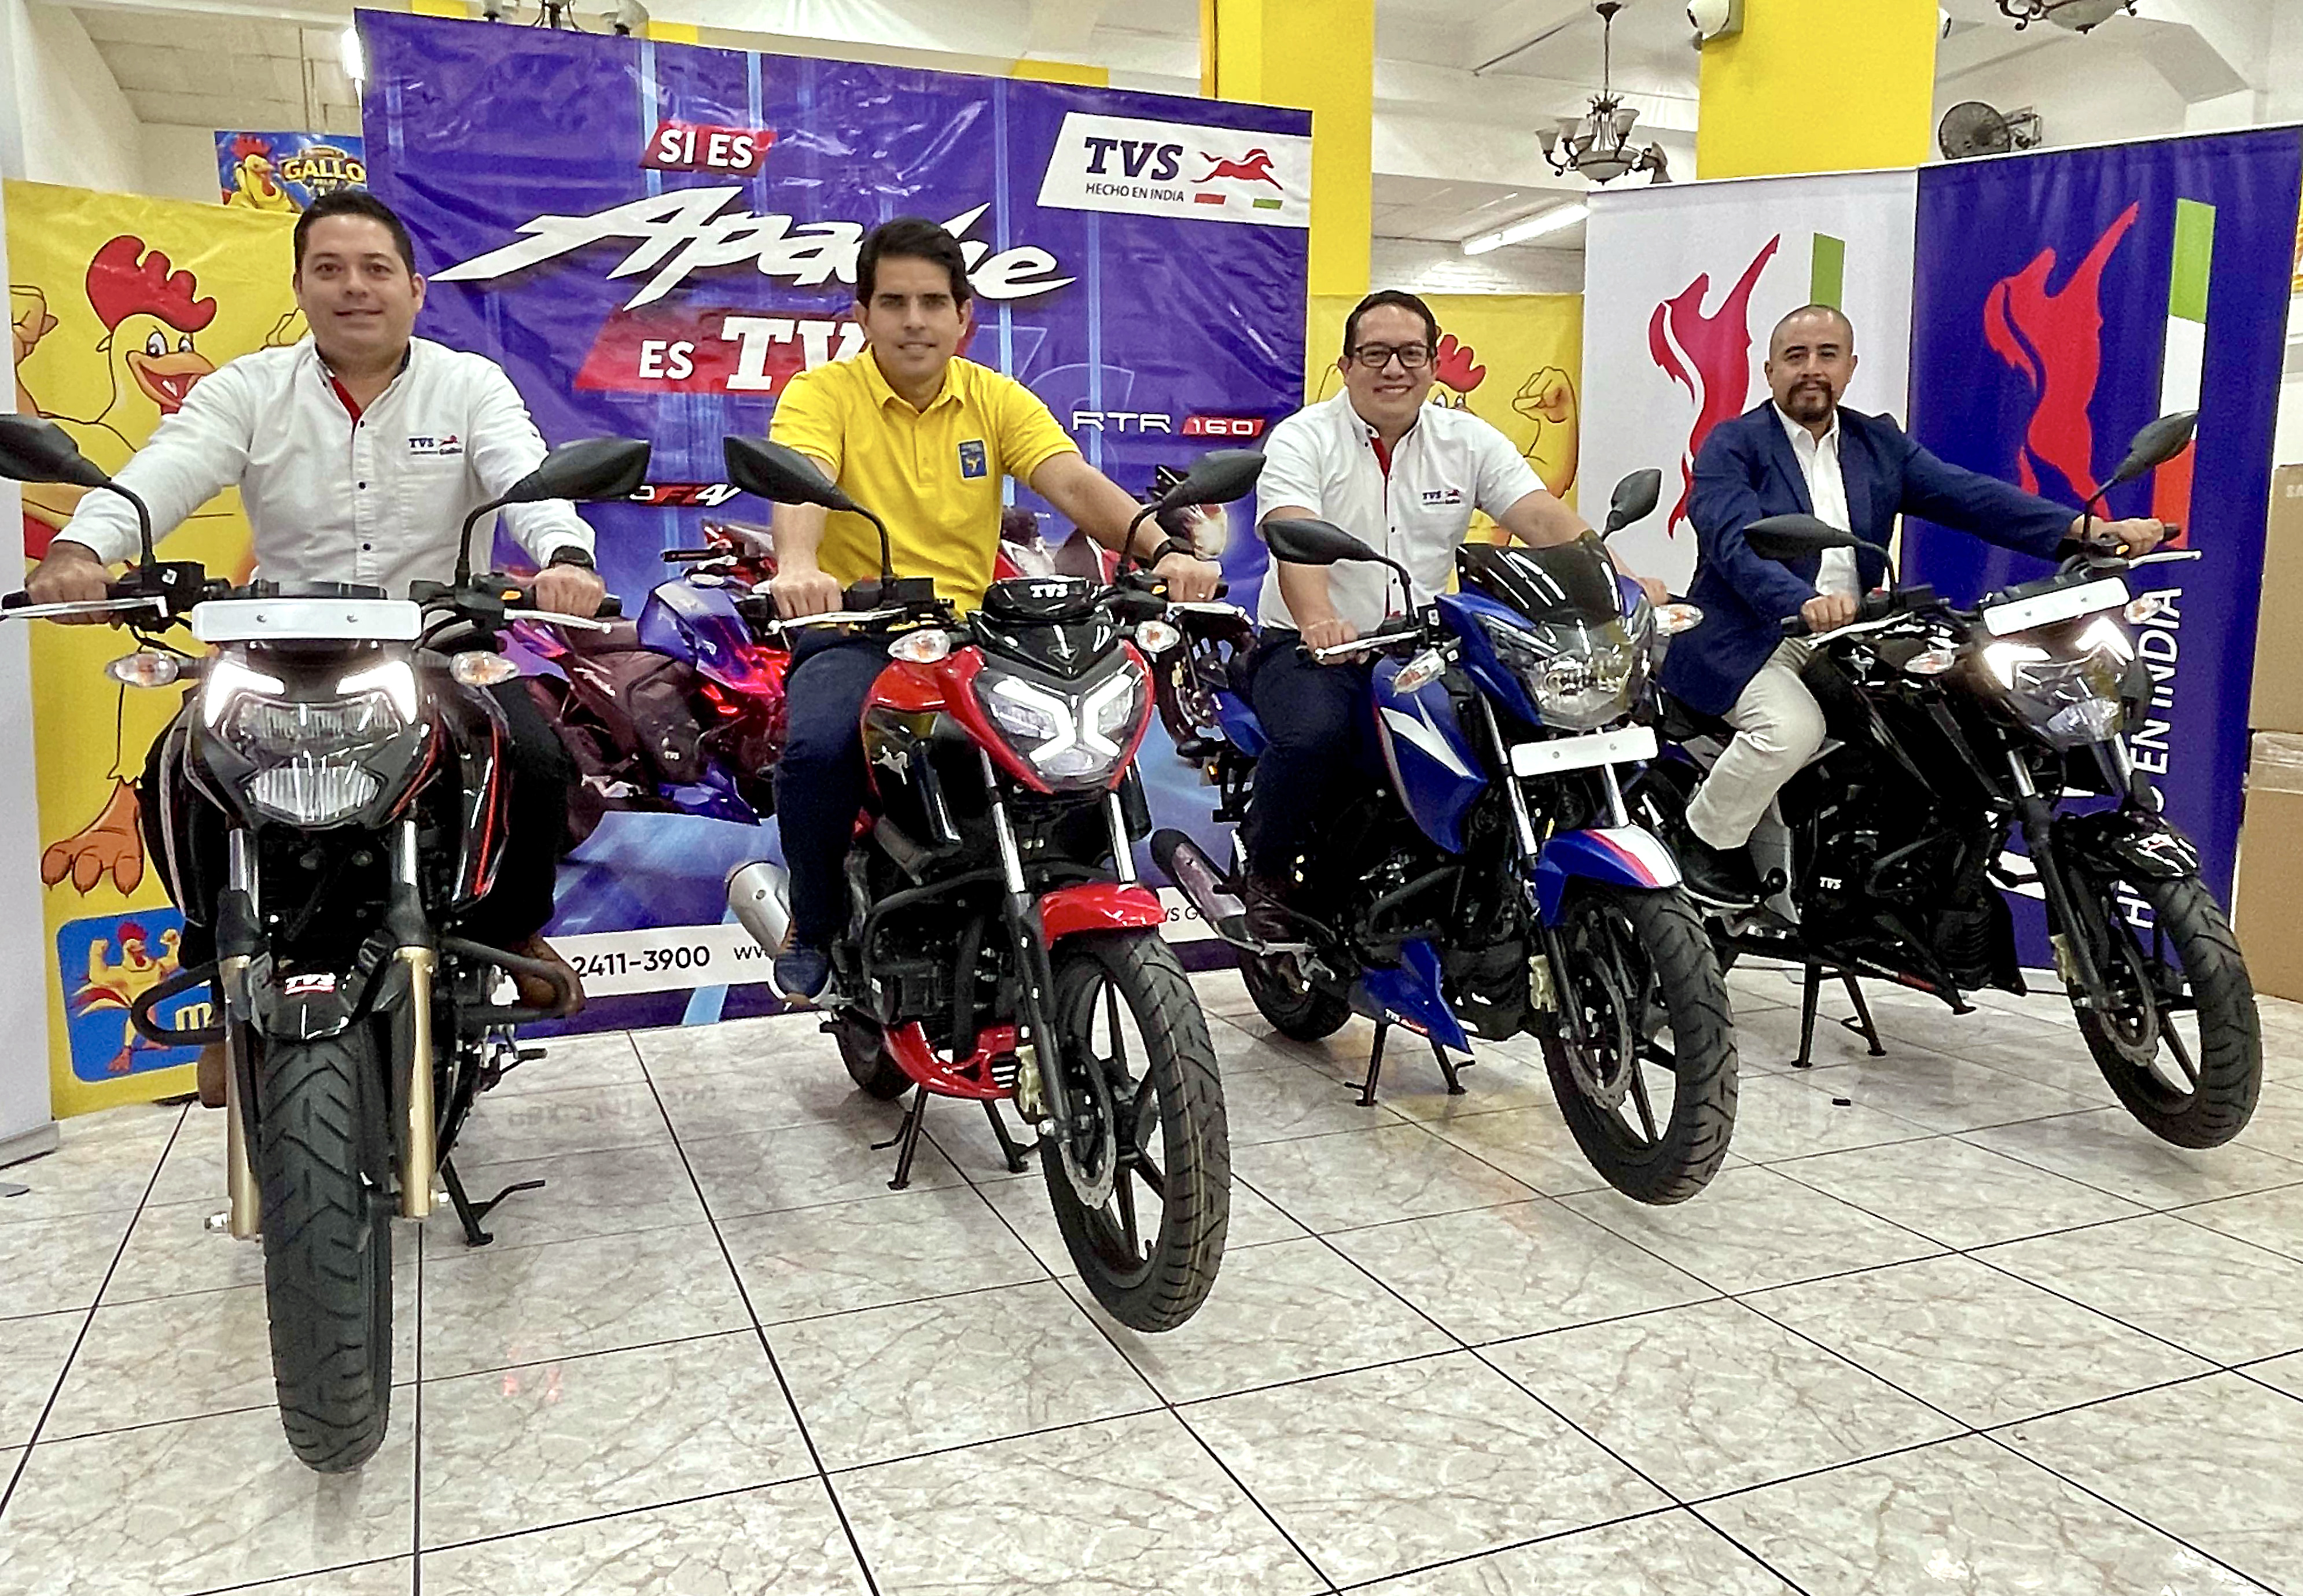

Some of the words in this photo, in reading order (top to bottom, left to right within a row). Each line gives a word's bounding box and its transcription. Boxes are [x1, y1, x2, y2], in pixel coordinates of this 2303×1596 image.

[657, 128, 696, 164] SI
[707, 133, 754, 169] ES
[1084, 137, 1184, 181] TVS
[283, 159, 367, 182] GALLO
[1085, 183, 1129, 196] HECHO
[1132, 186, 1147, 199] EN
[1150, 188, 1184, 202] INDIA
[428, 186, 1076, 311] Apae
[639, 340, 695, 380] ES
[721, 316, 866, 390] TV
[1072, 411, 1171, 433] RTR
[1193, 418, 1254, 435] 160
[1029, 583, 1069, 598] TVS
[2130, 719, 2170, 774] EN
[1819, 876, 1842, 890] TVS
[571, 945, 711, 977] 2411-3900
